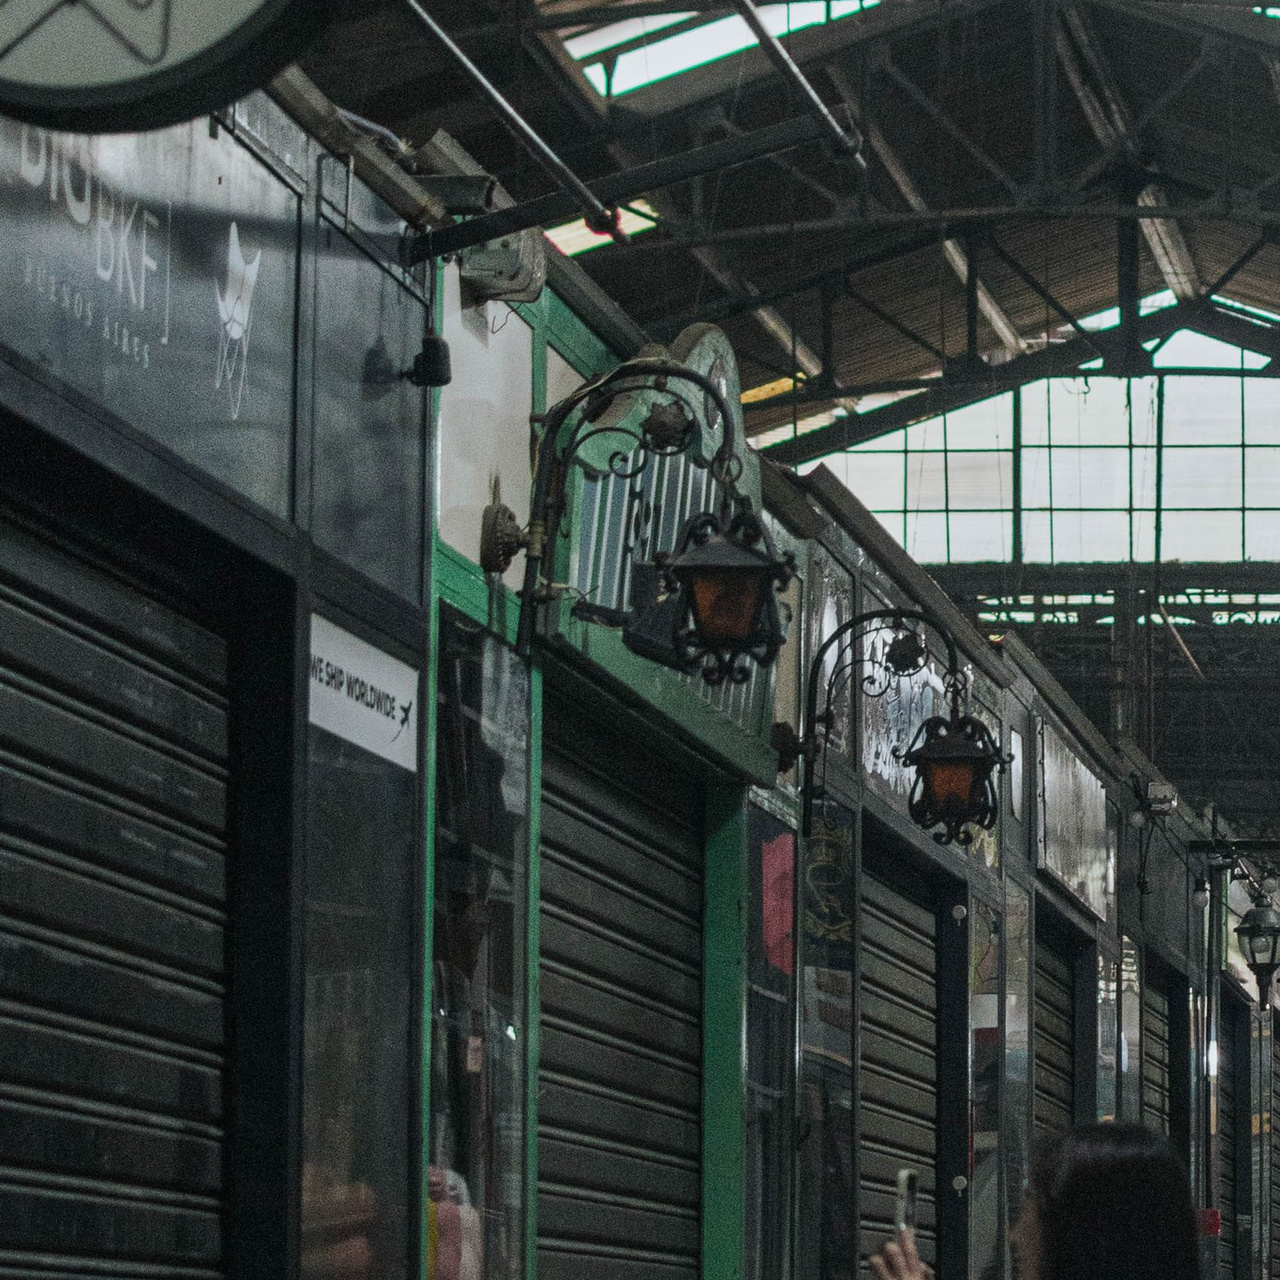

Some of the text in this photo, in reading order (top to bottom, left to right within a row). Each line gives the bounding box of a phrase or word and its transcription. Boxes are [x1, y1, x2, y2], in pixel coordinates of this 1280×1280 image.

[310, 655, 396, 720] WE SHIP WORLDWIDE
